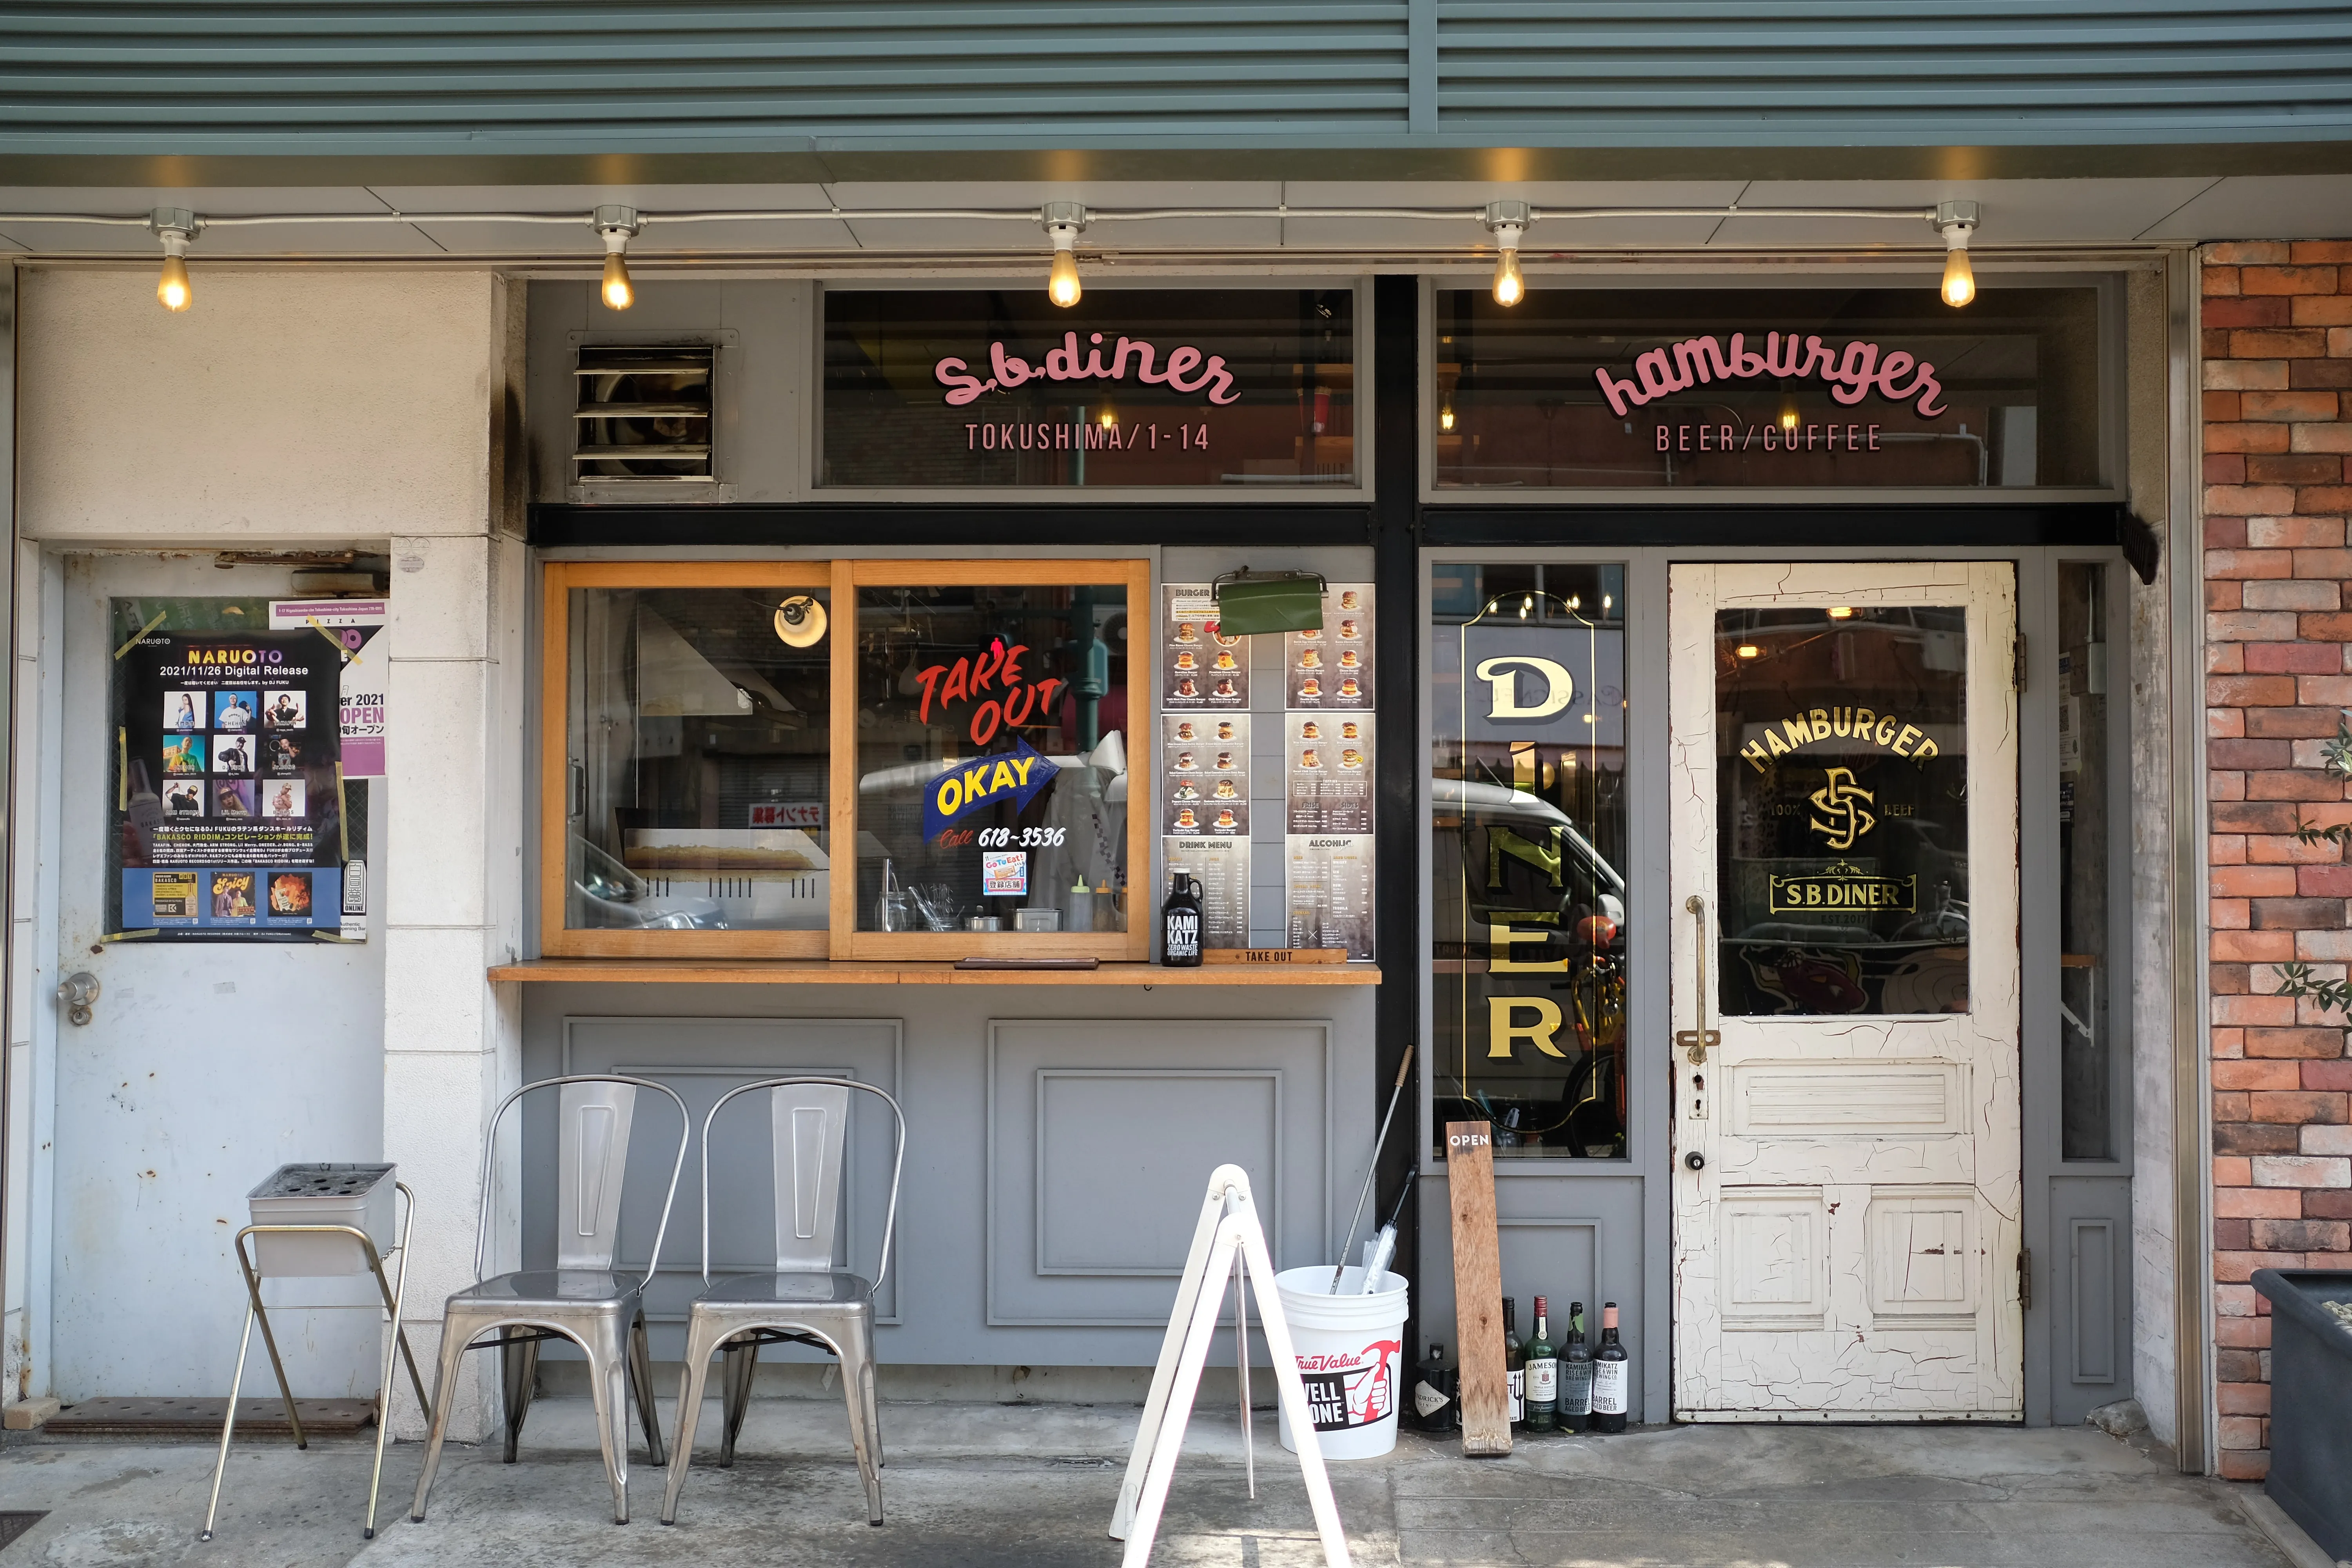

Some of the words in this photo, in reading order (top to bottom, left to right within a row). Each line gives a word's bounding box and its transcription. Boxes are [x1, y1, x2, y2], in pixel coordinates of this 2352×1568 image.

[1596, 331, 1948, 416] hamburger
[965, 423, 1209, 450] TOKUSHIMA/1-14
[1657, 425, 1881, 451] BEER/COFFEE
[189, 650, 282, 664] NARUOTO
[160, 666, 221, 676] 2021/11/26
[225, 666, 259, 677] Digital
[264, 666, 308, 675] Release
[916, 644, 1030, 725] TAKE
[356, 693, 384, 706] 2021
[340, 707, 384, 724] OPEN
[970, 678, 1062, 746] OUT
[340, 724, 384, 735] 旬オープン
[1740, 706, 1939, 774] HAMBURGER
[937, 757, 1035, 816] OKAY
[1884, 804, 1915, 817] BEEF
[937, 829, 974, 849] Call
[1475, 656, 1573, 1058] DINER
[1167, 915, 1198, 930] KAMI
[1167, 930, 1198, 944] KATZ
[1245, 951, 1269, 962] TAKE
[1274, 951, 1292, 962] OUT
[1450, 1134, 1489, 1146] OPEN
[1312, 1353, 1361, 1371] Value
[1594, 1361, 1618, 1369] AMIKATZ
[1415, 1393, 1443, 1403] NDRICK'S
[1593, 1394, 1617, 1405] BARREL
[1308, 1401, 1343, 1423] ONE
